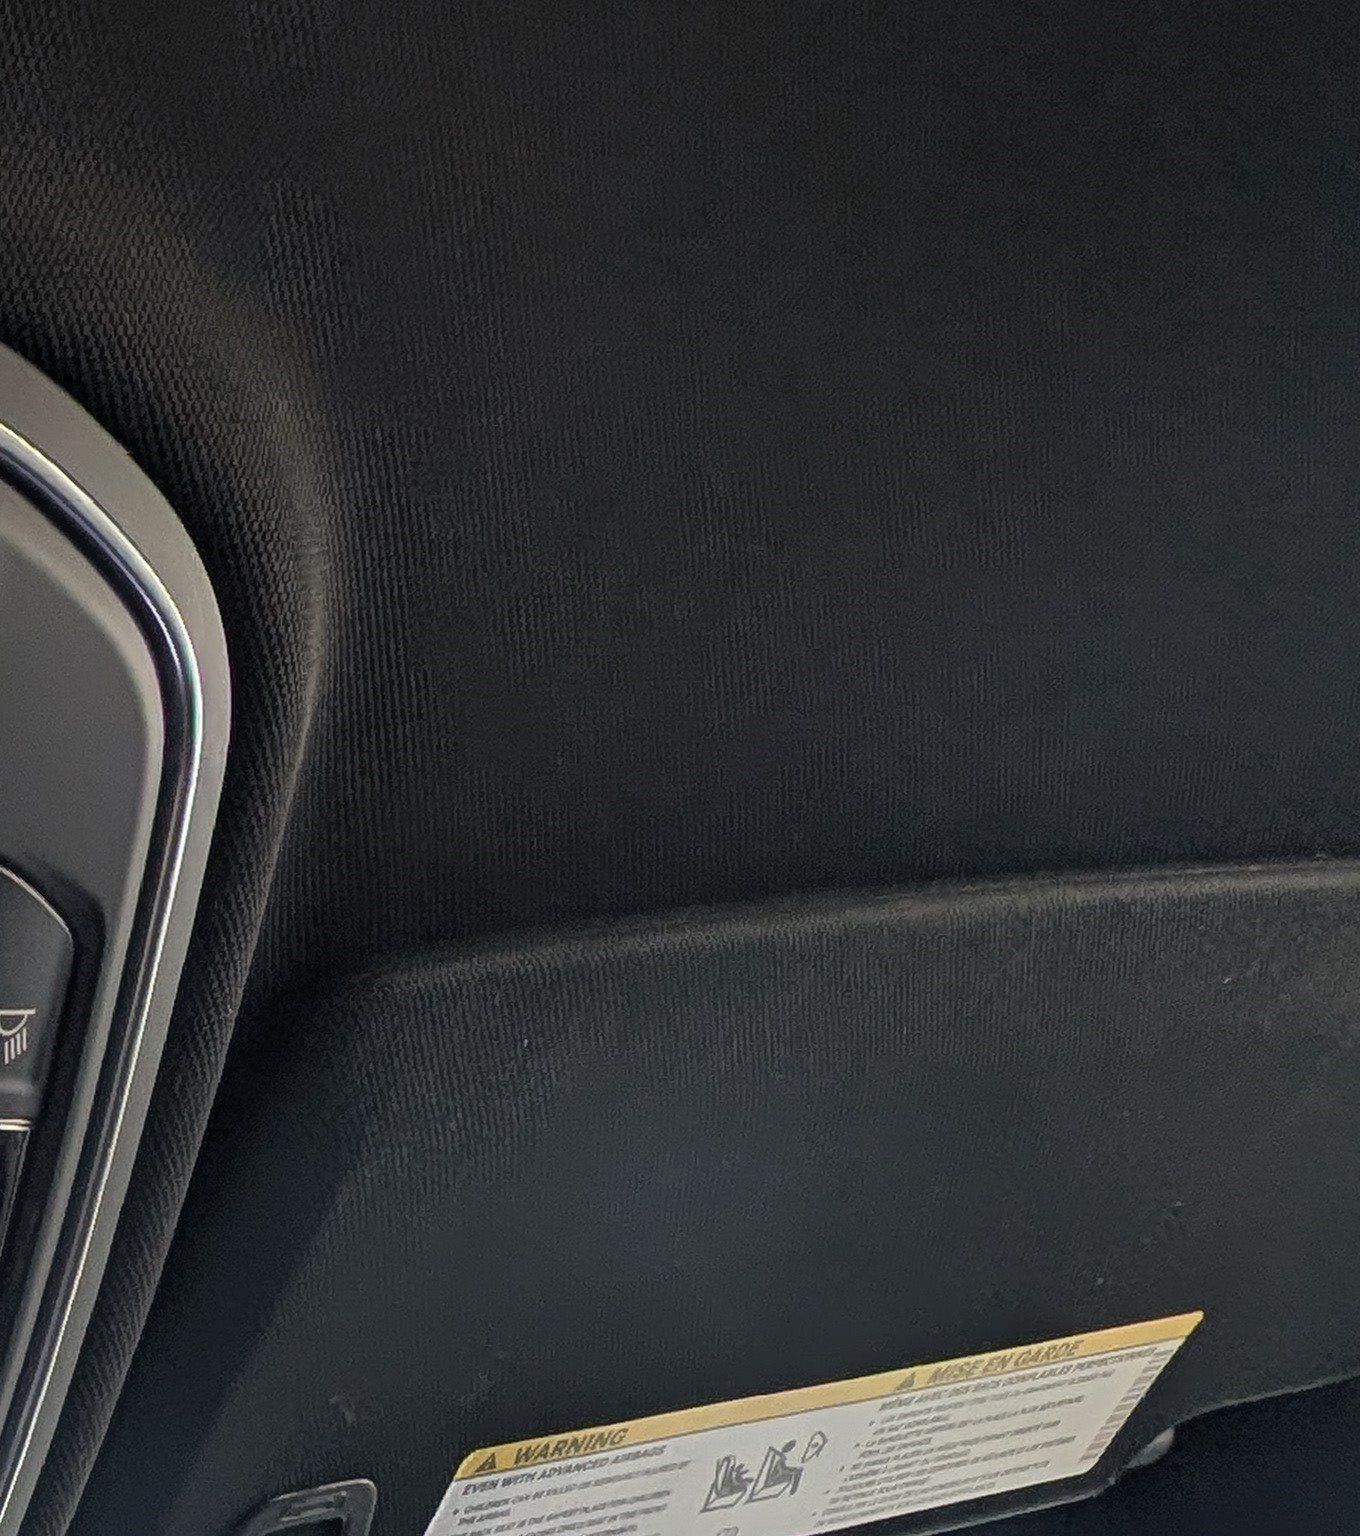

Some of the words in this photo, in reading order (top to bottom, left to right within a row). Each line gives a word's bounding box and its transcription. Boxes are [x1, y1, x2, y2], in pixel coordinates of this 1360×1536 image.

[928, 1358, 984, 1385] MISE
[983, 1352, 1016, 1372] EN
[1014, 1341, 1083, 1367] GARDE
[513, 1429, 630, 1464] WARNING
[537, 1457, 609, 1480] ADVANCED
